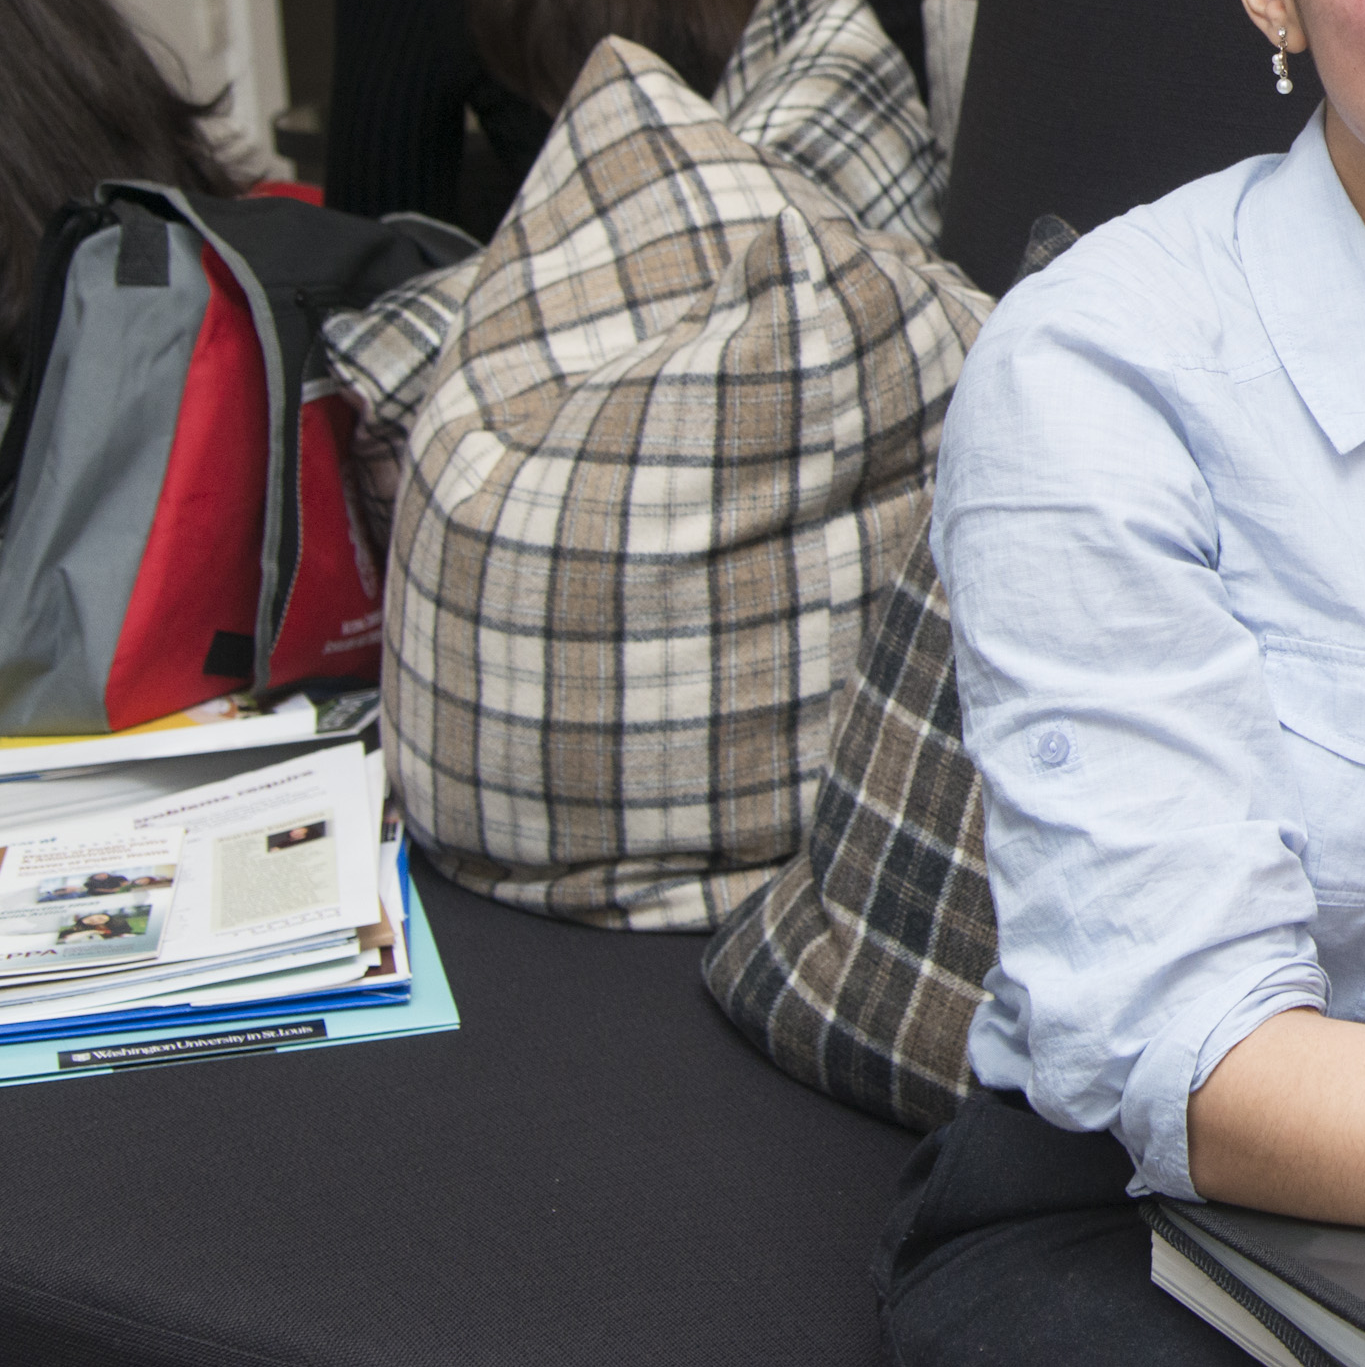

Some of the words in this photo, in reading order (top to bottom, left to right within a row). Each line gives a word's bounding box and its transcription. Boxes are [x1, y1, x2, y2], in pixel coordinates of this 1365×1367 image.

[93, 1041, 176, 1060] Washington
[176, 1035, 246, 1050] University
[247, 1032, 262, 1041] in
